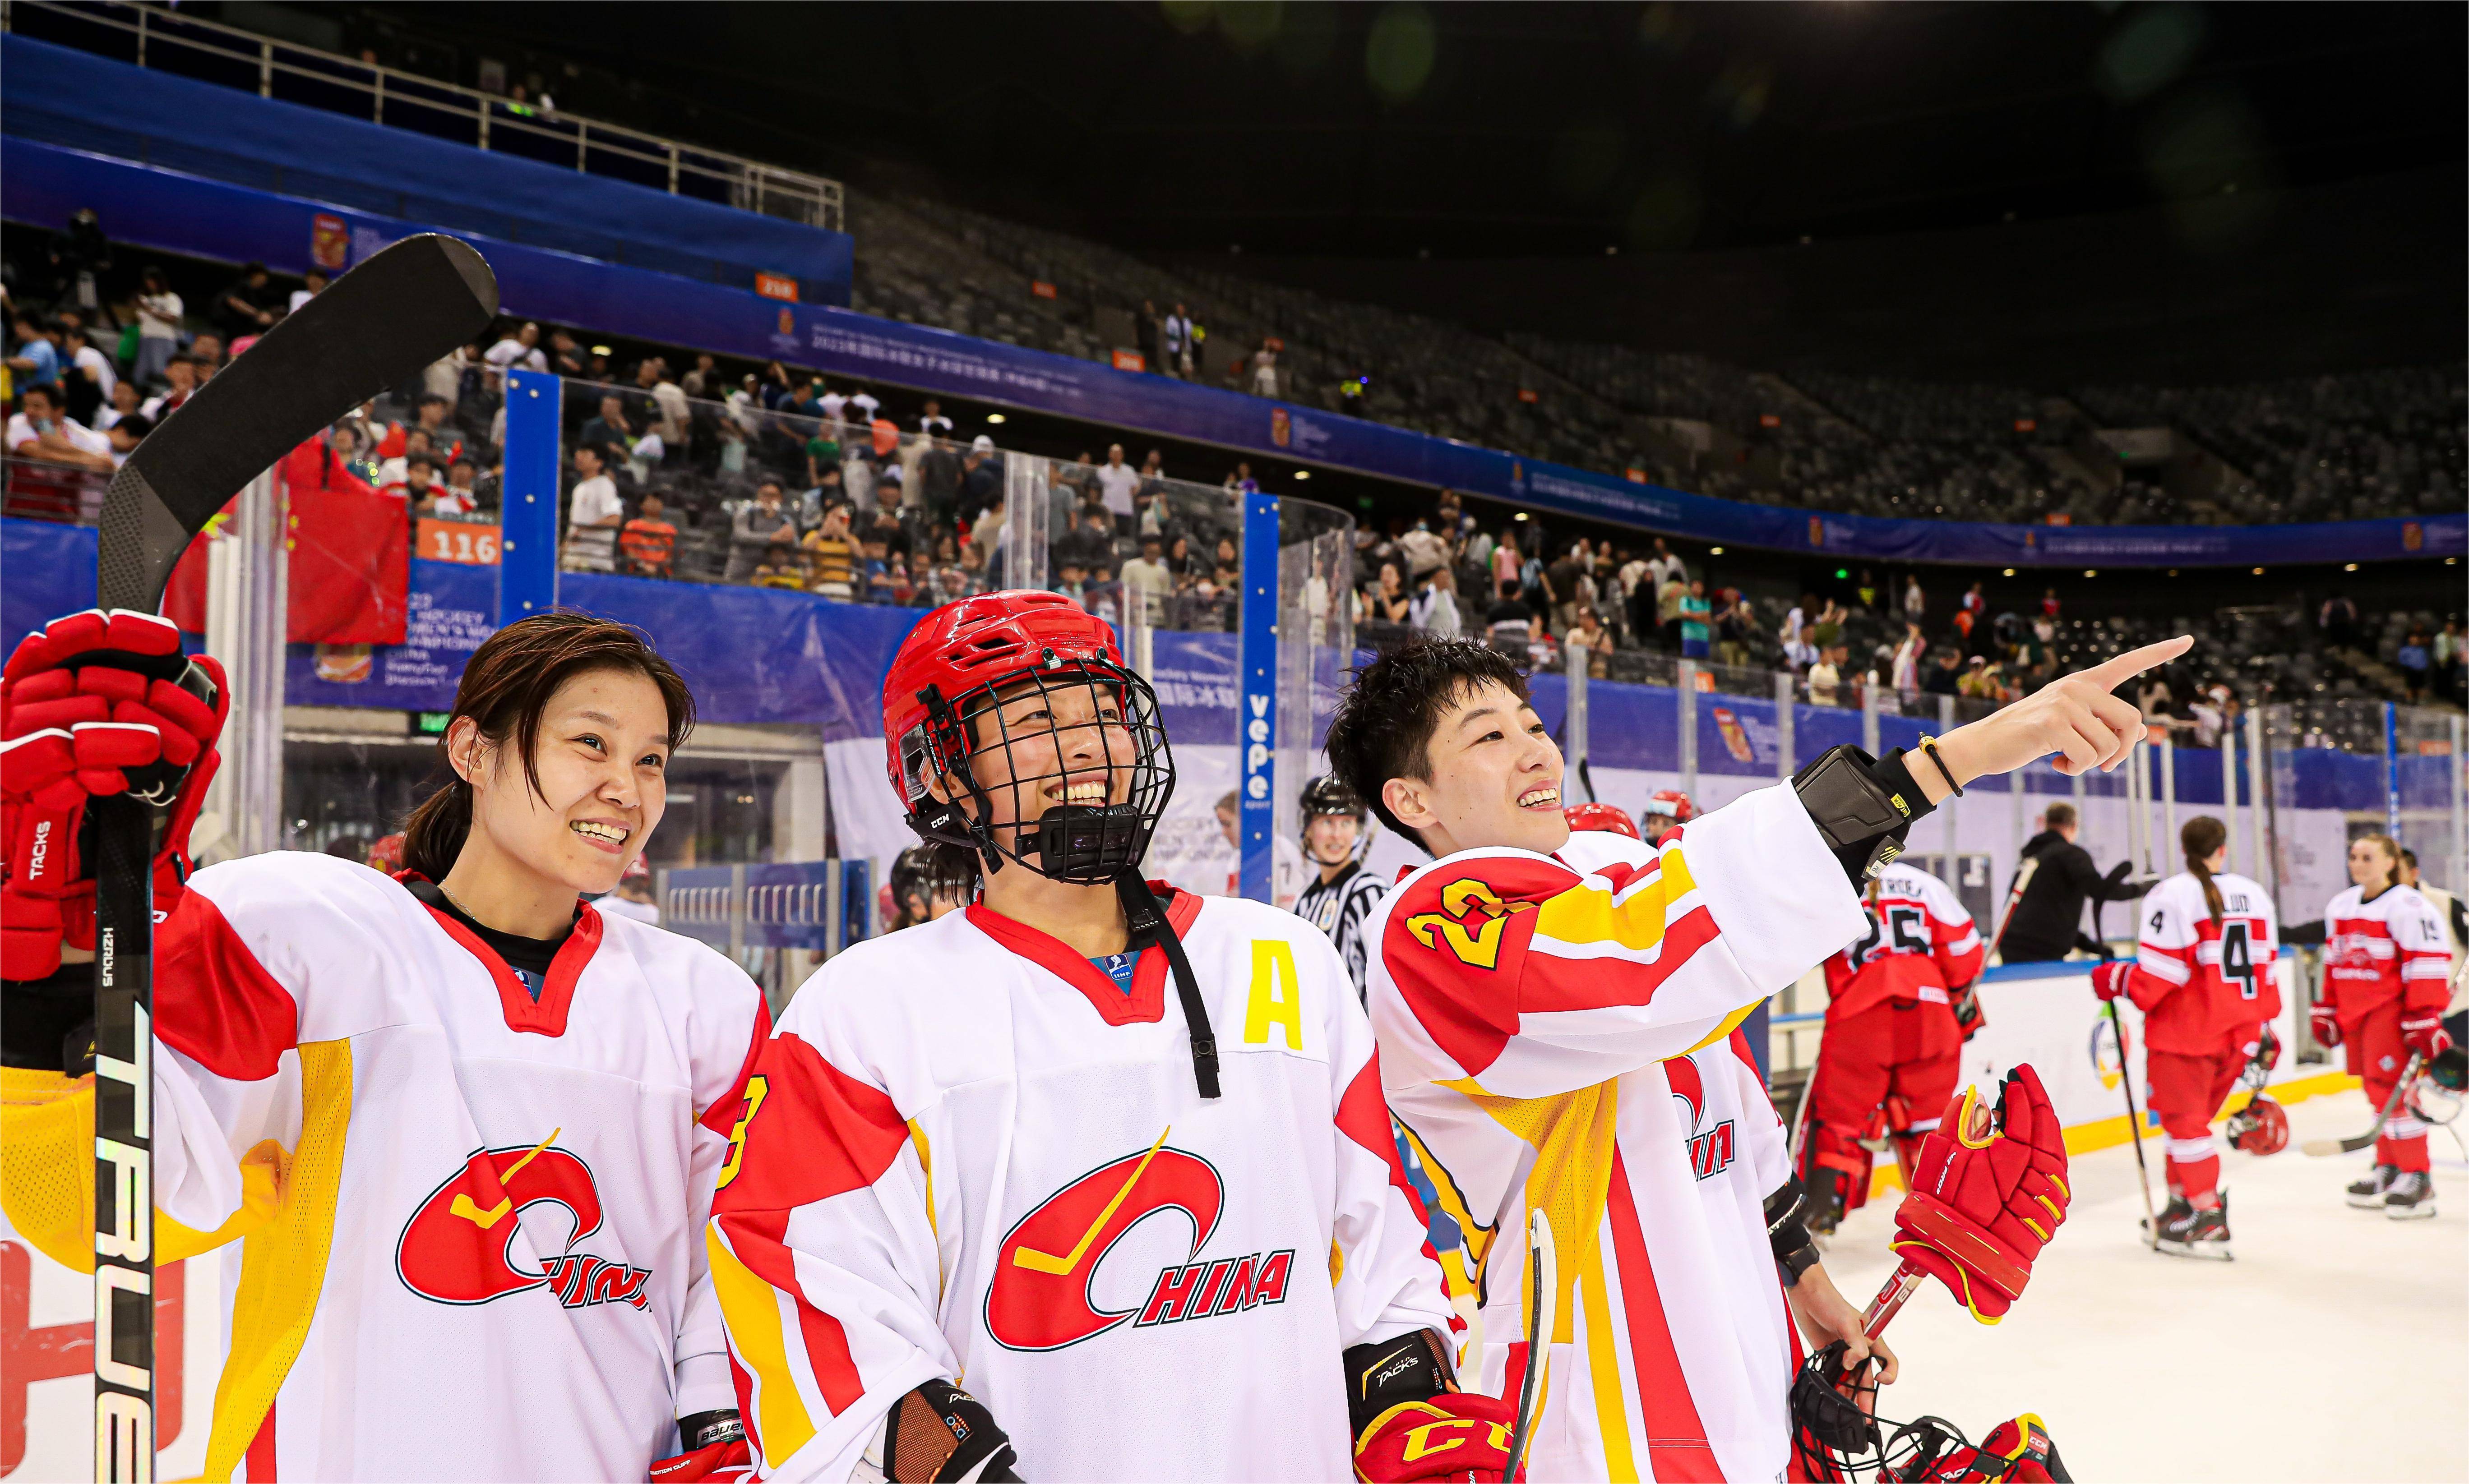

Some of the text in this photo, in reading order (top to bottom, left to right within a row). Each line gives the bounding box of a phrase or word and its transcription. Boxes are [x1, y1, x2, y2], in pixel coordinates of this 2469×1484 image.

[434, 530, 497, 564] 116
[1248, 694, 1270, 800] vepe
[29, 820, 51, 880] TACKS
[930, 813, 950, 829] CCM
[2150, 910, 2164, 934] 4
[102, 927, 114, 987] HZRDUS
[2222, 923, 2254, 995] 4
[1244, 939, 1303, 1051] A
[95, 1000, 152, 1484] TRUE
[983, 1145, 1296, 1353] CHINA
[1377, 1357, 1419, 1387] TACKS
[673, 1459, 692, 1470] CUFF
[1402, 1419, 1517, 1463] CC
